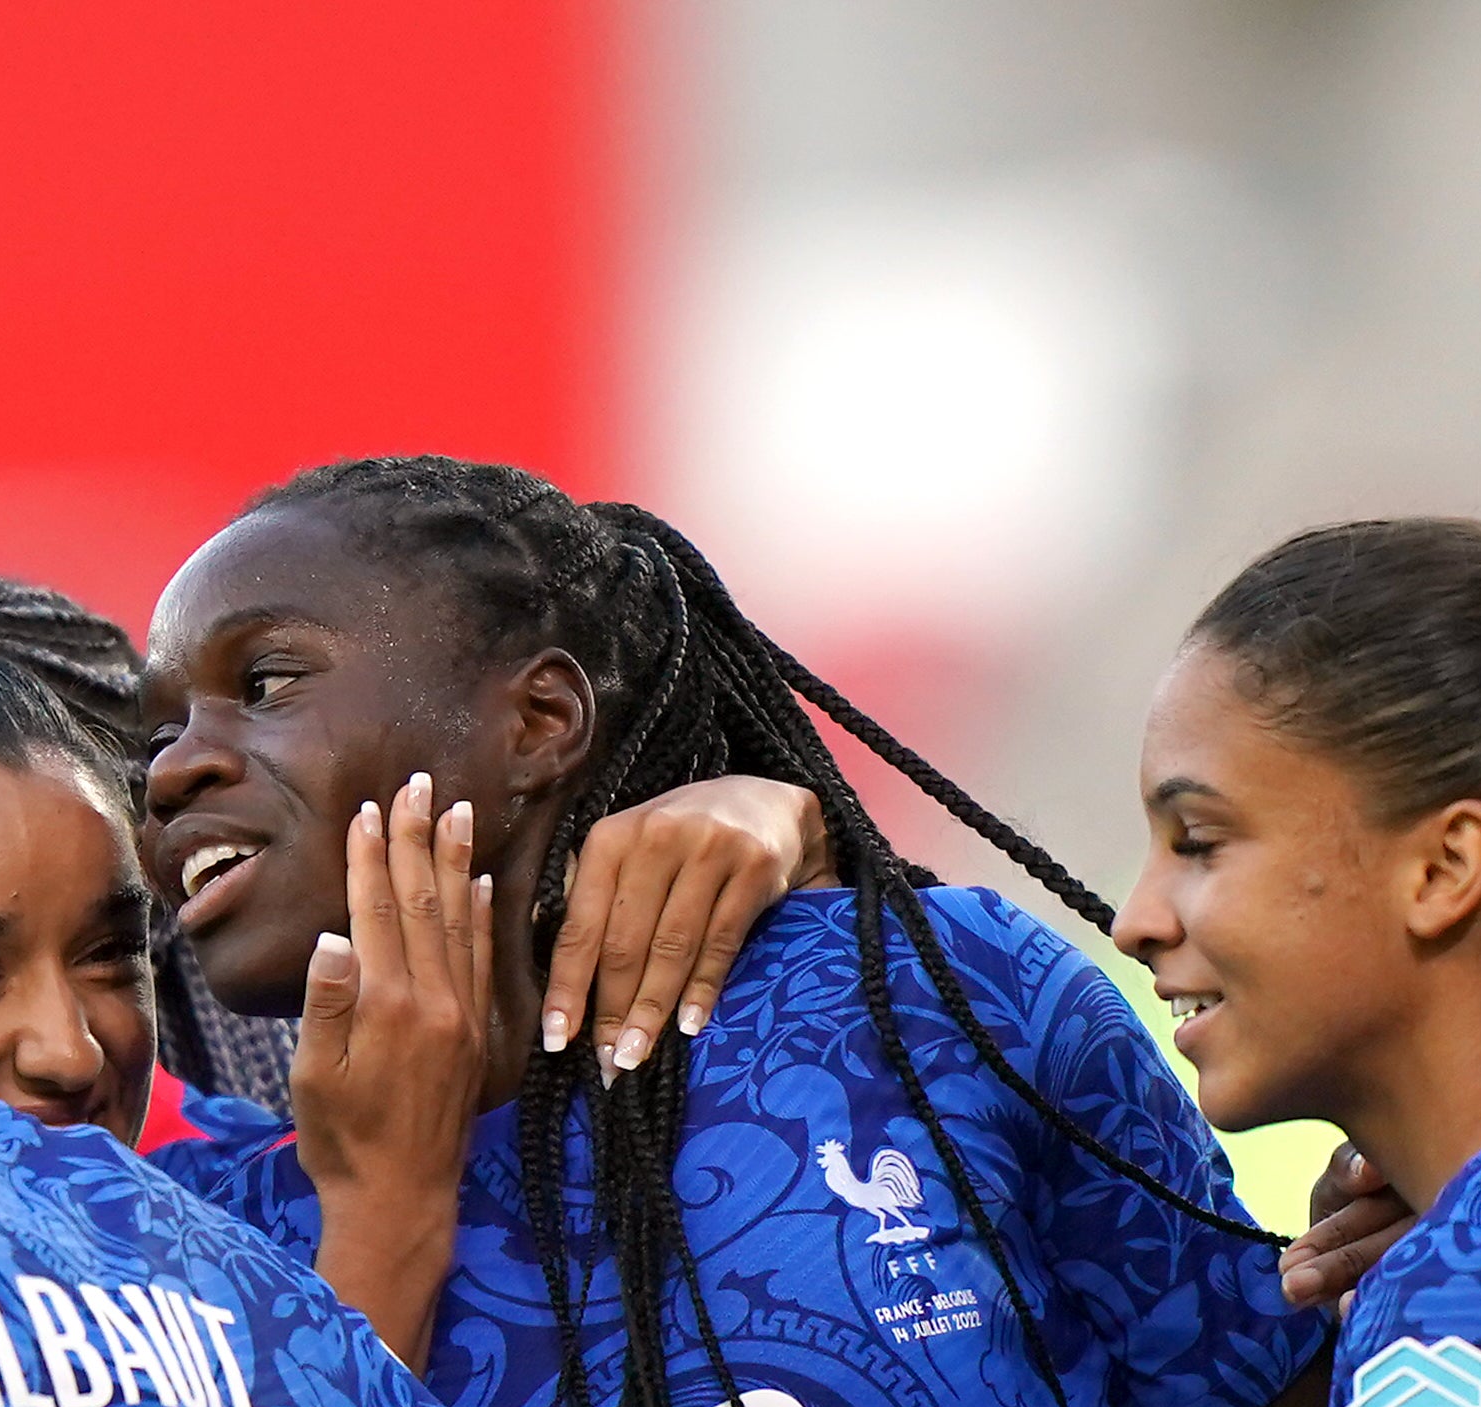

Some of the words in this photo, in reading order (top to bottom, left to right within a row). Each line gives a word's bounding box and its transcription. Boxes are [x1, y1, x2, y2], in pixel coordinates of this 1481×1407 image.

[875, 1299, 924, 1325] FRANCE
[931, 1289, 978, 1310] BELGIQUE
[892, 1327, 910, 1344] 14
[913, 1316, 952, 1339] JUILLET
[952, 1311, 982, 1330] 2022
